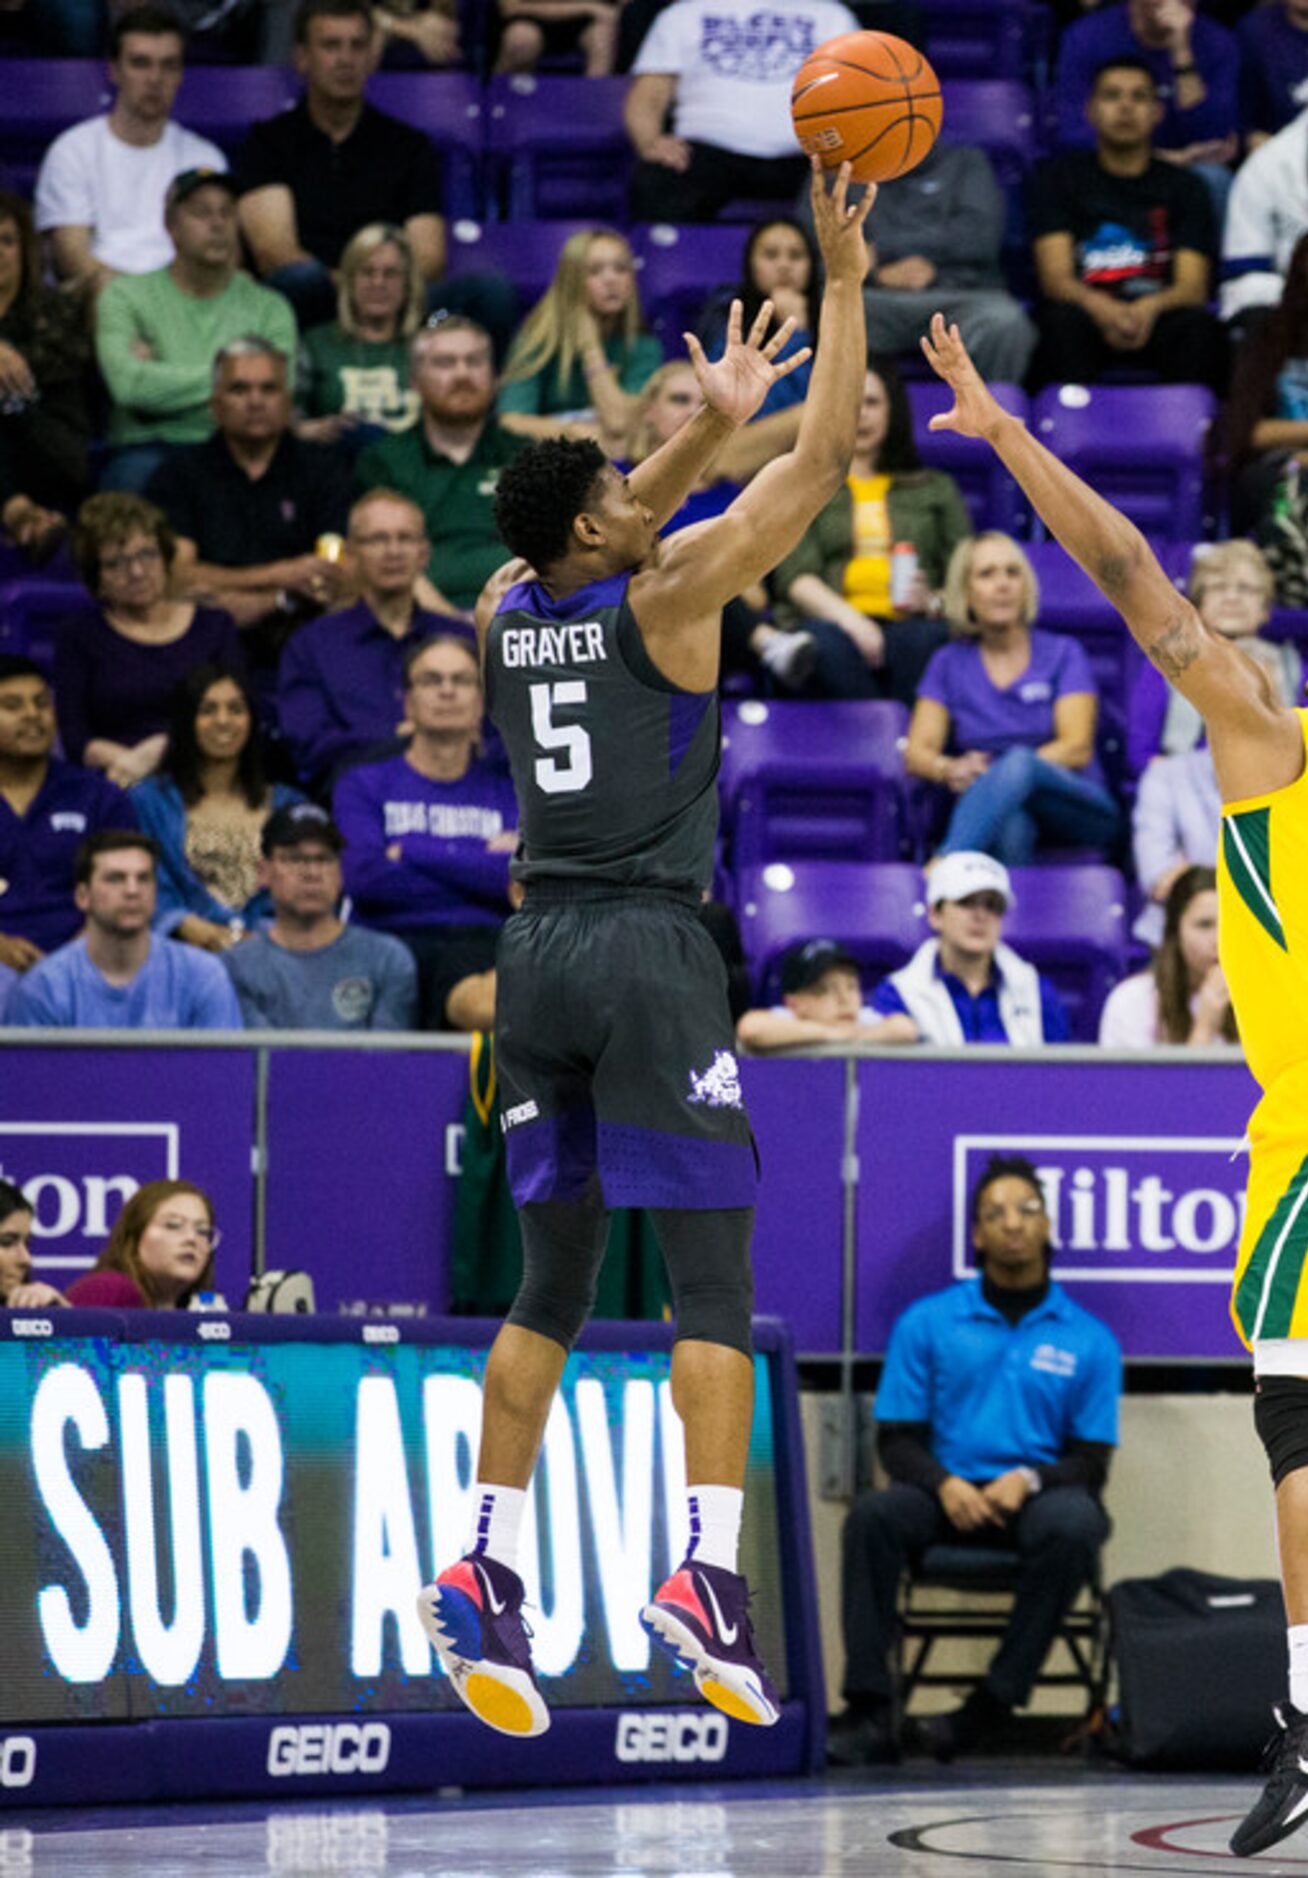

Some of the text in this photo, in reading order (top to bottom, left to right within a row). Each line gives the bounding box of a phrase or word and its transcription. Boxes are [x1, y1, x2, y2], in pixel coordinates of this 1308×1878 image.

[502, 622, 607, 668] GRAYER
[529, 680, 592, 793] 5
[1035, 1166, 1237, 1253] ilto
[31, 1363, 294, 1685] SUB
[267, 1722, 391, 1776] GEICO
[615, 1712, 729, 1763] GEICO
